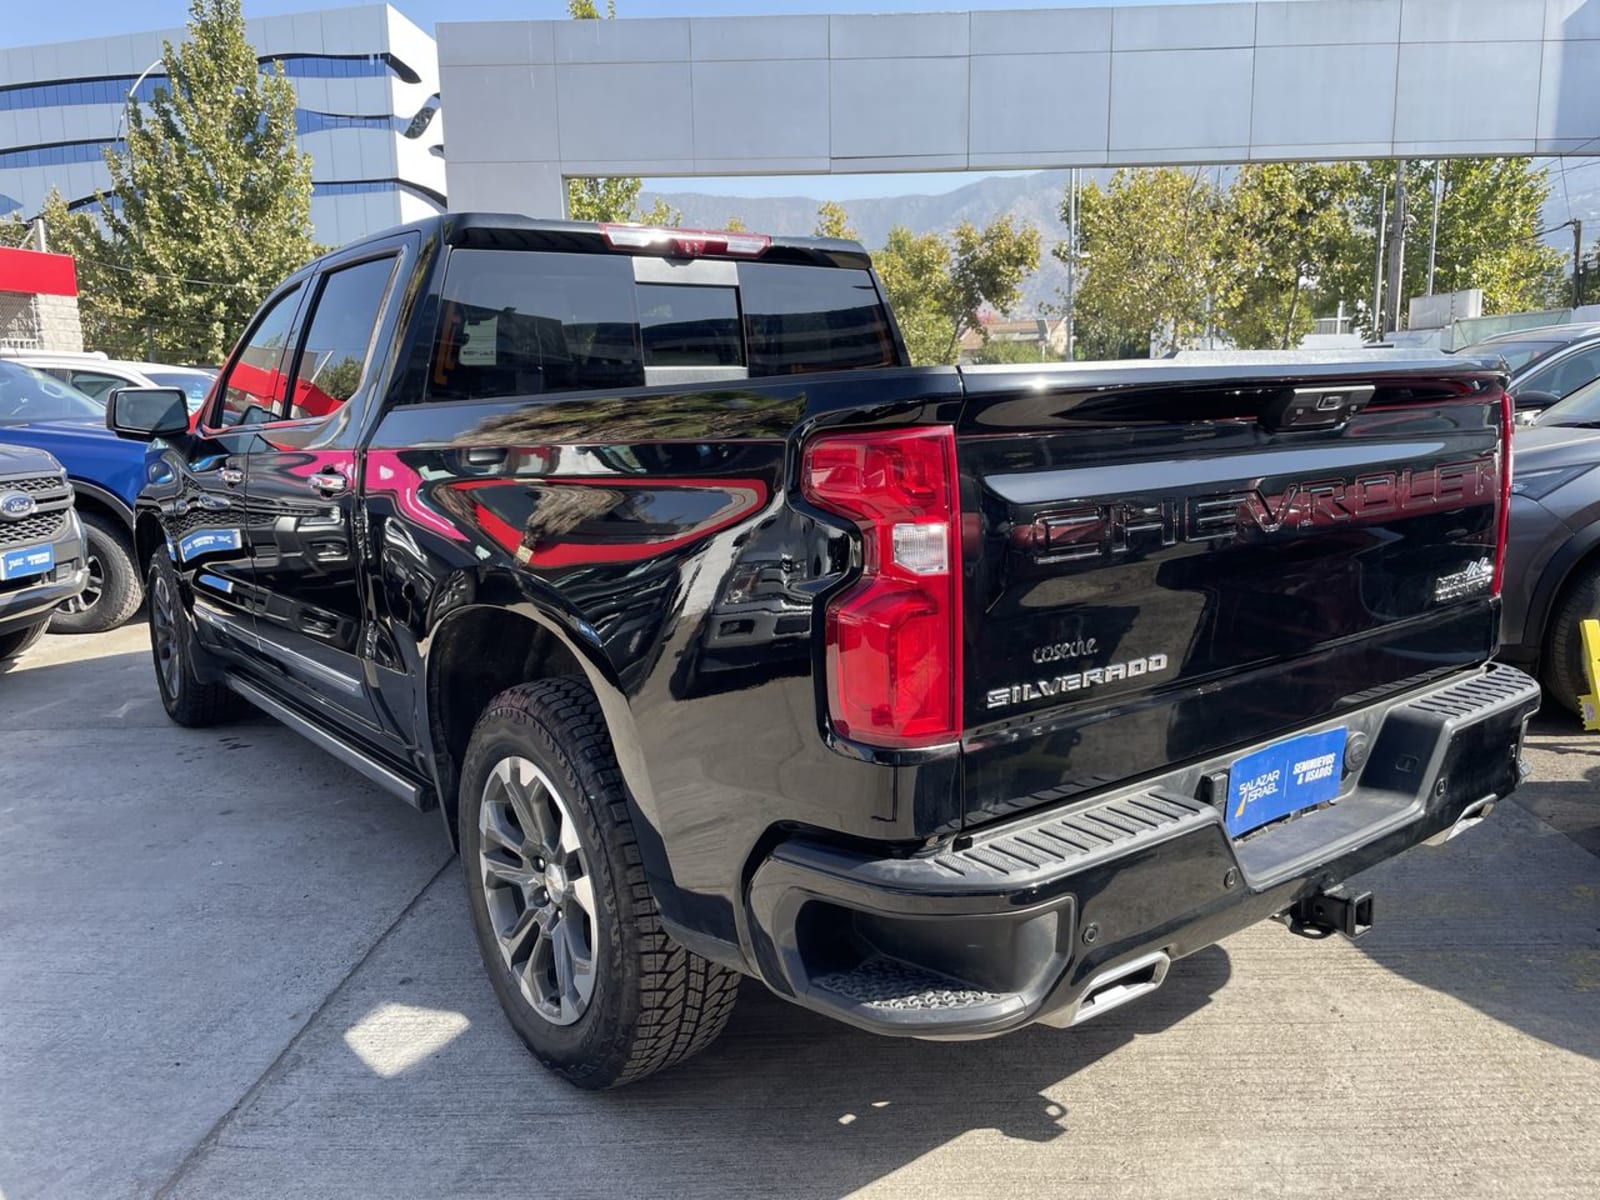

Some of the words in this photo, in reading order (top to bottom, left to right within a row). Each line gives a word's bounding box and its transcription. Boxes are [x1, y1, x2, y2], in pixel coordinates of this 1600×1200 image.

[10, 499, 30, 512] Ford
[1032, 455, 1495, 564] CHEVROLET
[986, 653, 1168, 709] SILVERADO
[1239, 769, 1281, 796] SALAZAR
[1247, 783, 1279, 802] ISRAEL
